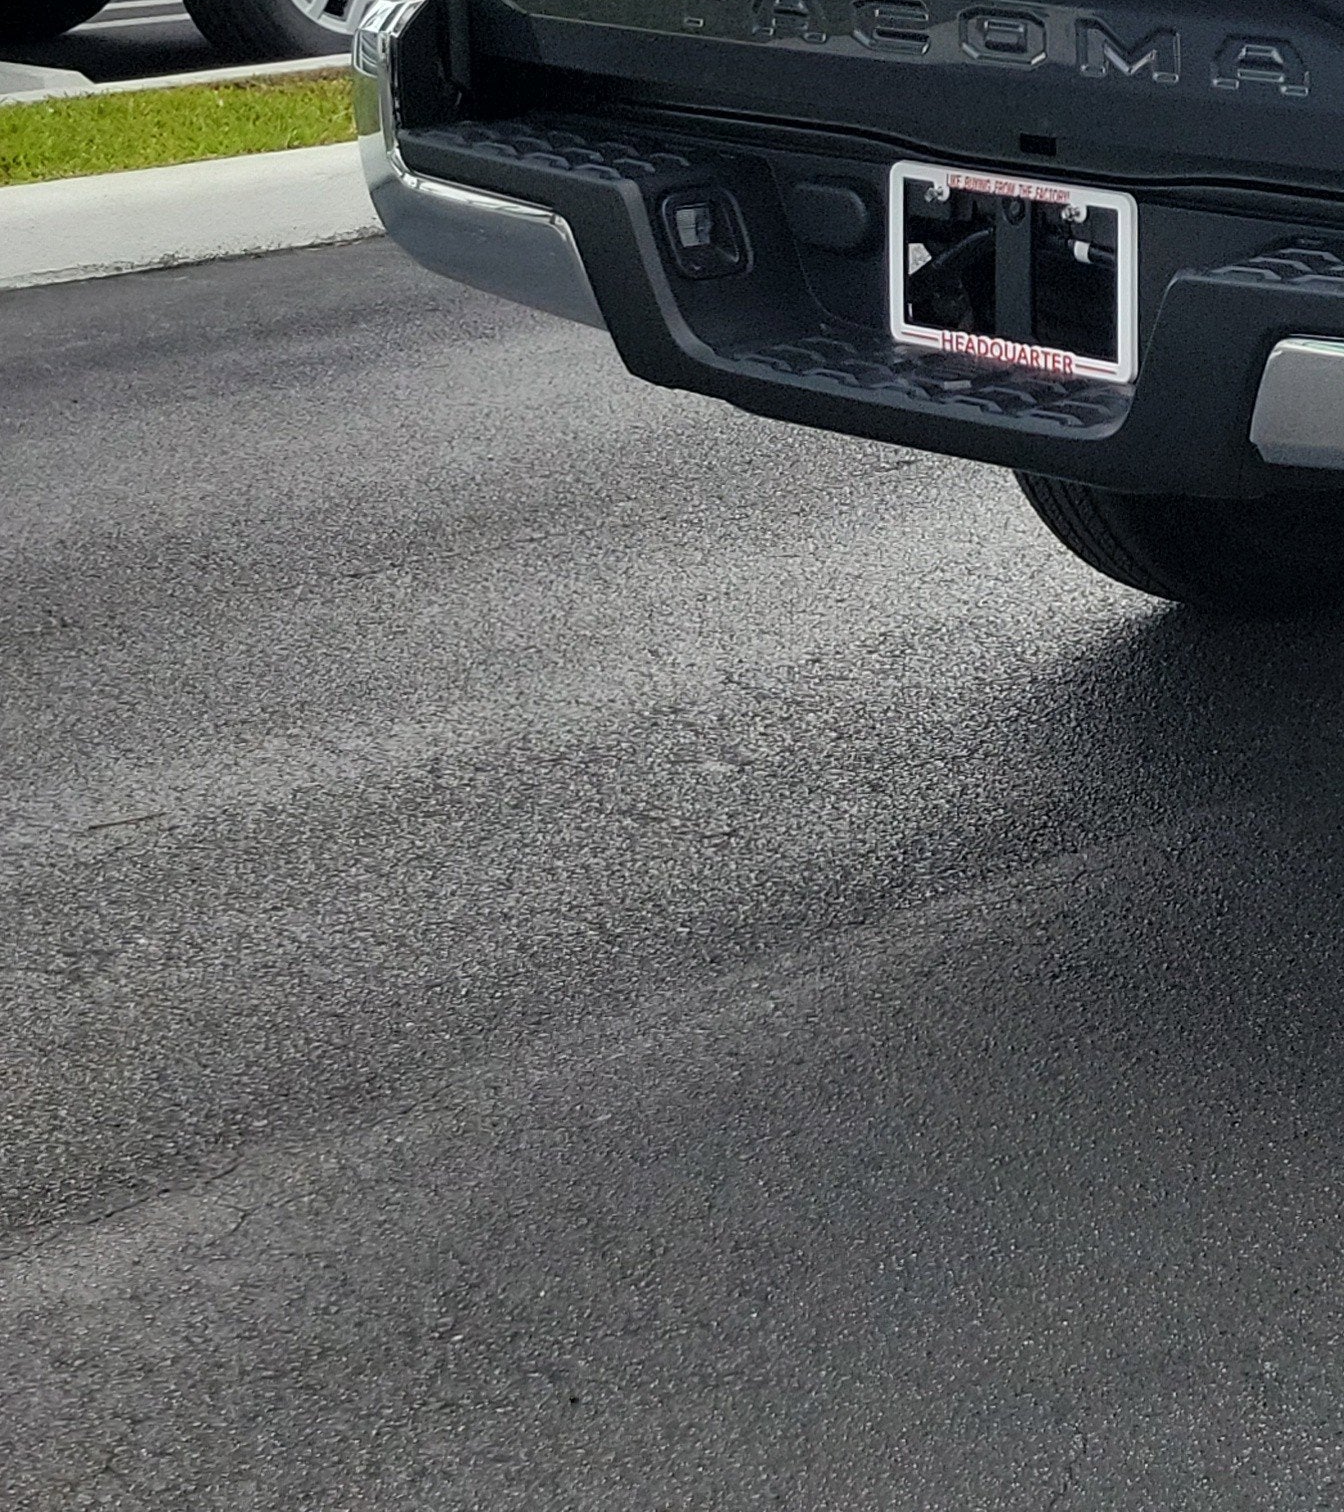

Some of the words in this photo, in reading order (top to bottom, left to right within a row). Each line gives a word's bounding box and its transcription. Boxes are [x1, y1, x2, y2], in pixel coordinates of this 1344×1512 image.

[946, 173, 962, 188] LIKE
[994, 180, 1016, 197] FROM
[1018, 184, 1033, 198] THE
[940, 331, 1074, 374] HEADQUARTER
